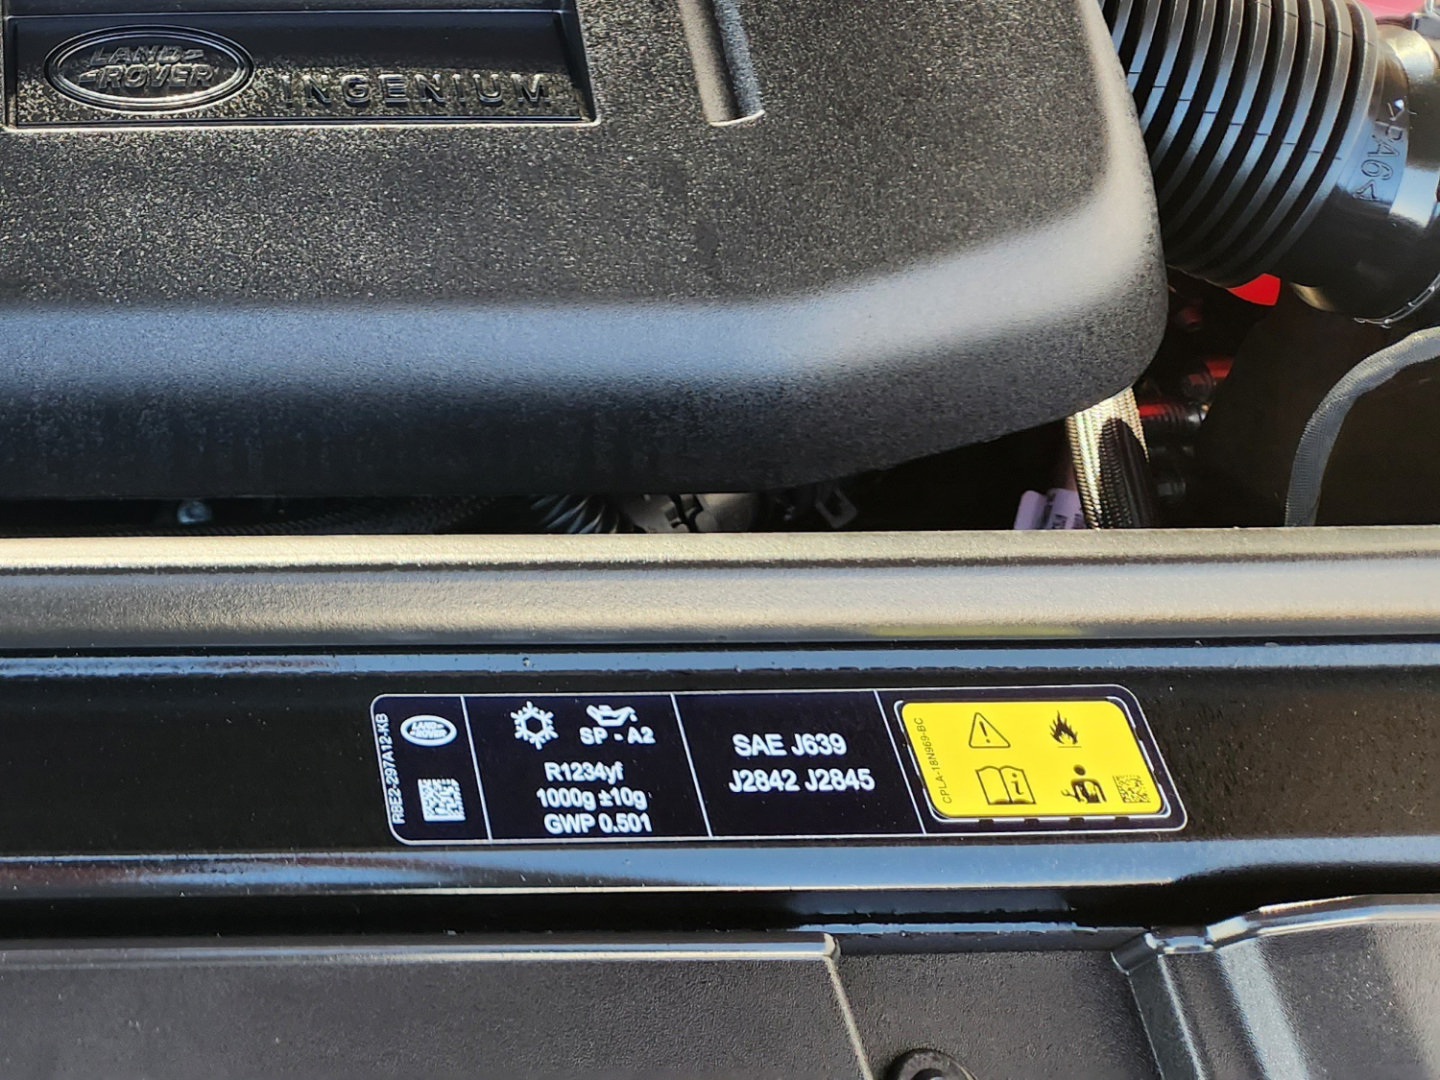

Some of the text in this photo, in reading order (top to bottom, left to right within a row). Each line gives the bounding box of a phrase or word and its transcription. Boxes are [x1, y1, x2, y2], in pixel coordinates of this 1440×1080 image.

[90, 45, 182, 66] LAND
[96, 63, 214, 90] ROVER
[279, 73, 552, 106] INGENIUM
[579, 726, 607, 744] SP
[627, 727, 656, 744] A2
[732, 732, 847, 757] SAE J639
[544, 761, 624, 785] R1234yf
[728, 768, 876, 793] J2842 J2845
[536, 788, 648, 811] 1000g ±10g
[543, 812, 652, 834] GWP 0.501
